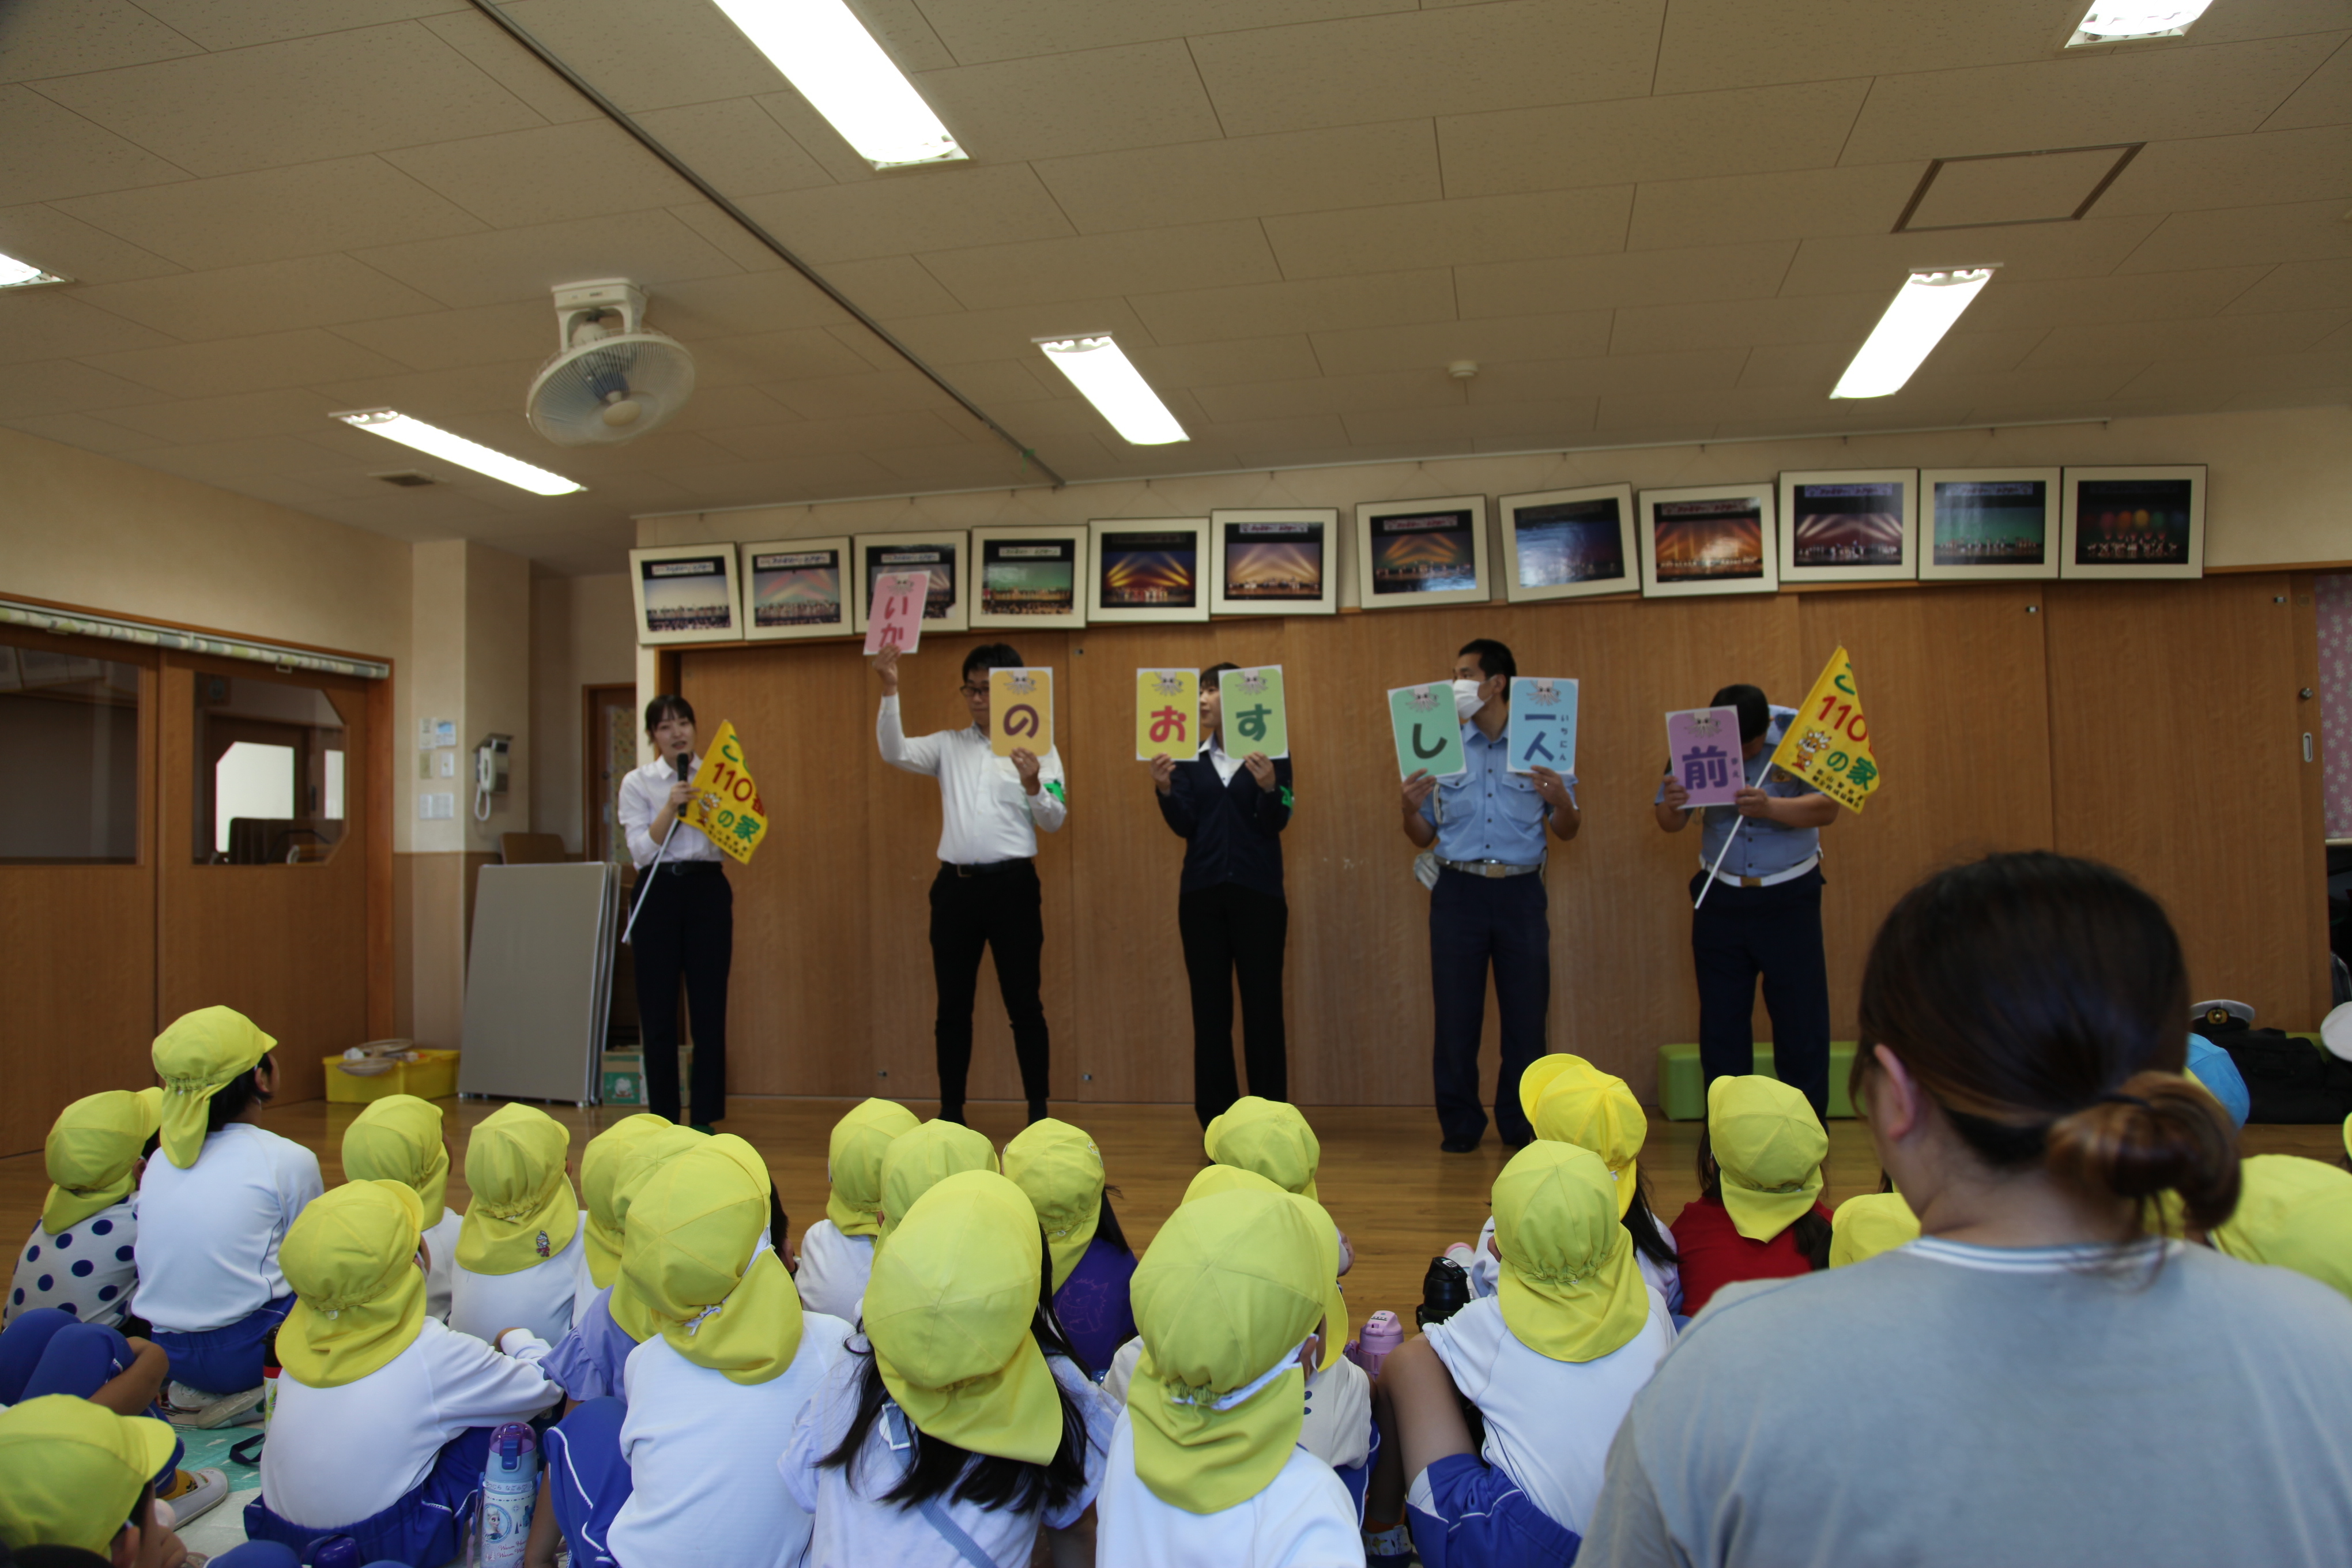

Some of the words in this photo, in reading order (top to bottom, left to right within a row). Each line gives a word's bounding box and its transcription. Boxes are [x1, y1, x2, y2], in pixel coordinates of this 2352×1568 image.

[879, 596, 909, 649] いか
[1003, 704, 1039, 738] の
[1149, 705, 1186, 742] お
[1236, 703, 1272, 741] す
[1523, 714, 1556, 762] 一人
[1559, 714, 1569, 762] いちにん
[1412, 723, 1448, 759] し
[1682, 745, 1728, 790] 前
[1827, 751, 1878, 791] の家
[717, 809, 761, 843] の家
